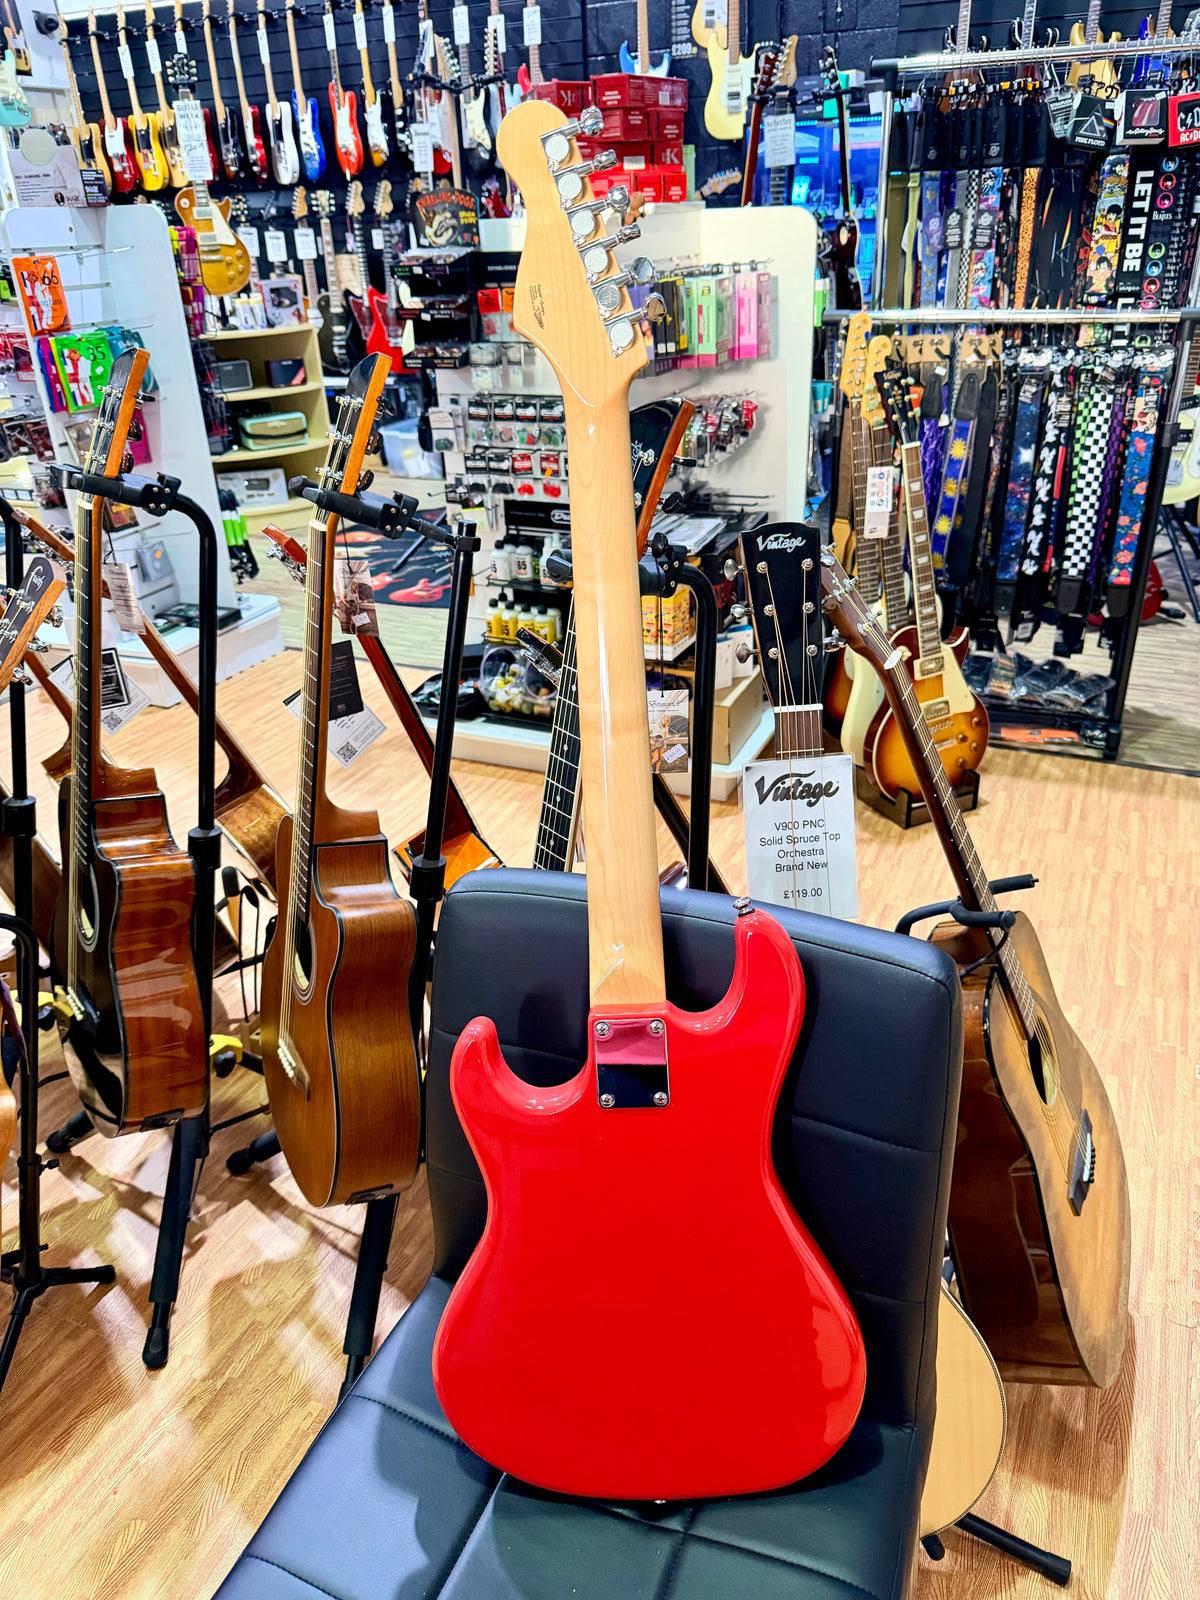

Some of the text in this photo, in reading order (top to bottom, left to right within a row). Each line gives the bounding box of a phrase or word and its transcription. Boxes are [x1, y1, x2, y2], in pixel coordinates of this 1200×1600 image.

[1132, 170, 1155, 213] LET
[1128, 216, 1148, 240] IT
[1122, 242, 1144, 272] BE
[42, 270, 59, 286] 66
[756, 532, 807, 553] Vintage
[754, 769, 840, 808] Vintage
[774, 818, 825, 832] V900 PNC
[759, 831, 841, 847] Solid Spruce Top
[777, 848, 824, 859] Orchestra
[775, 860, 828, 873] Brand New
[783, 888, 823, 900] £119.00
